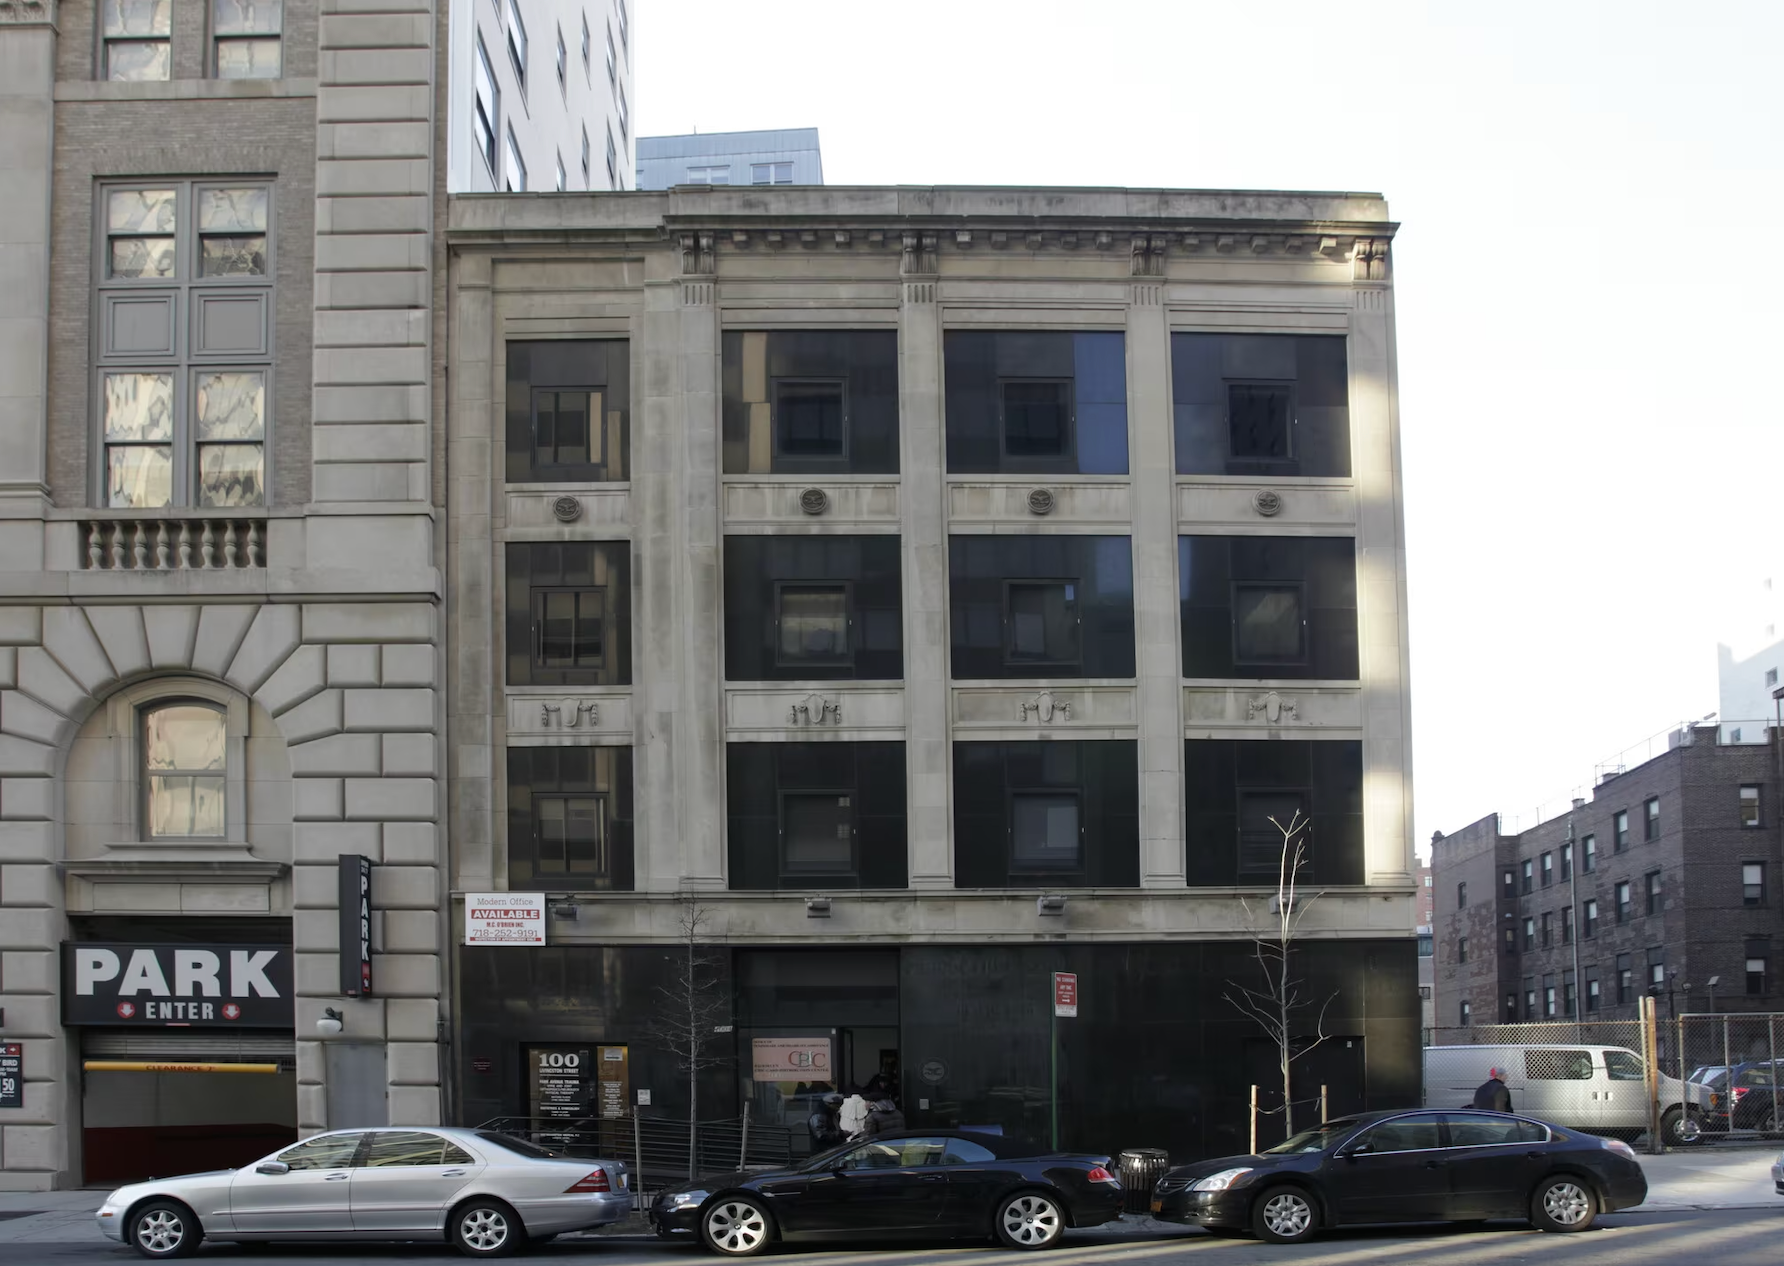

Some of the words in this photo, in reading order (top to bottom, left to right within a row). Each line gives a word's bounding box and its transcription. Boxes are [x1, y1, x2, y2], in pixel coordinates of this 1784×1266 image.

[361, 874, 369, 961] PARK
[473, 910, 538, 919] AVAILABLE
[472, 929, 538, 937] 718-252-9191
[75, 948, 281, 998] PARK
[145, 1001, 214, 1020] ENTER
[539, 1053, 580, 1067] 100
[2, 1078, 15, 1091] 50
